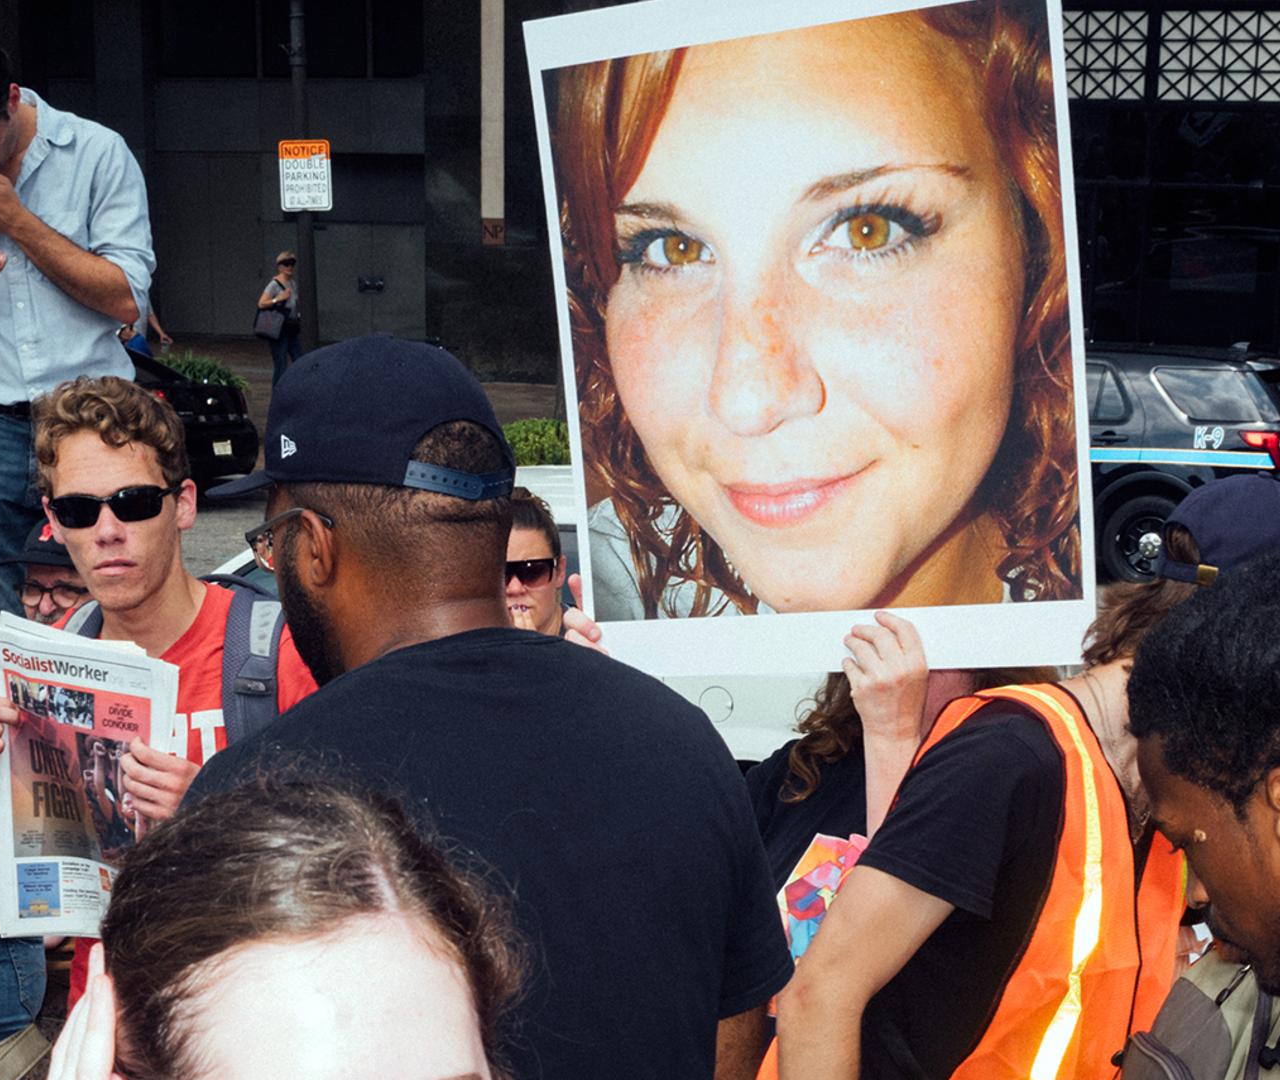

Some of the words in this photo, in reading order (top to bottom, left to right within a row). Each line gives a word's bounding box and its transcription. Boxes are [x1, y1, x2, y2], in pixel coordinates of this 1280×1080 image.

[284, 145, 325, 157] NOTICE
[285, 159, 325, 170] DOUBLE
[285, 171, 326, 181] PARKING
[483, 224, 504, 240] NP
[1193, 426, 1225, 449] K-9
